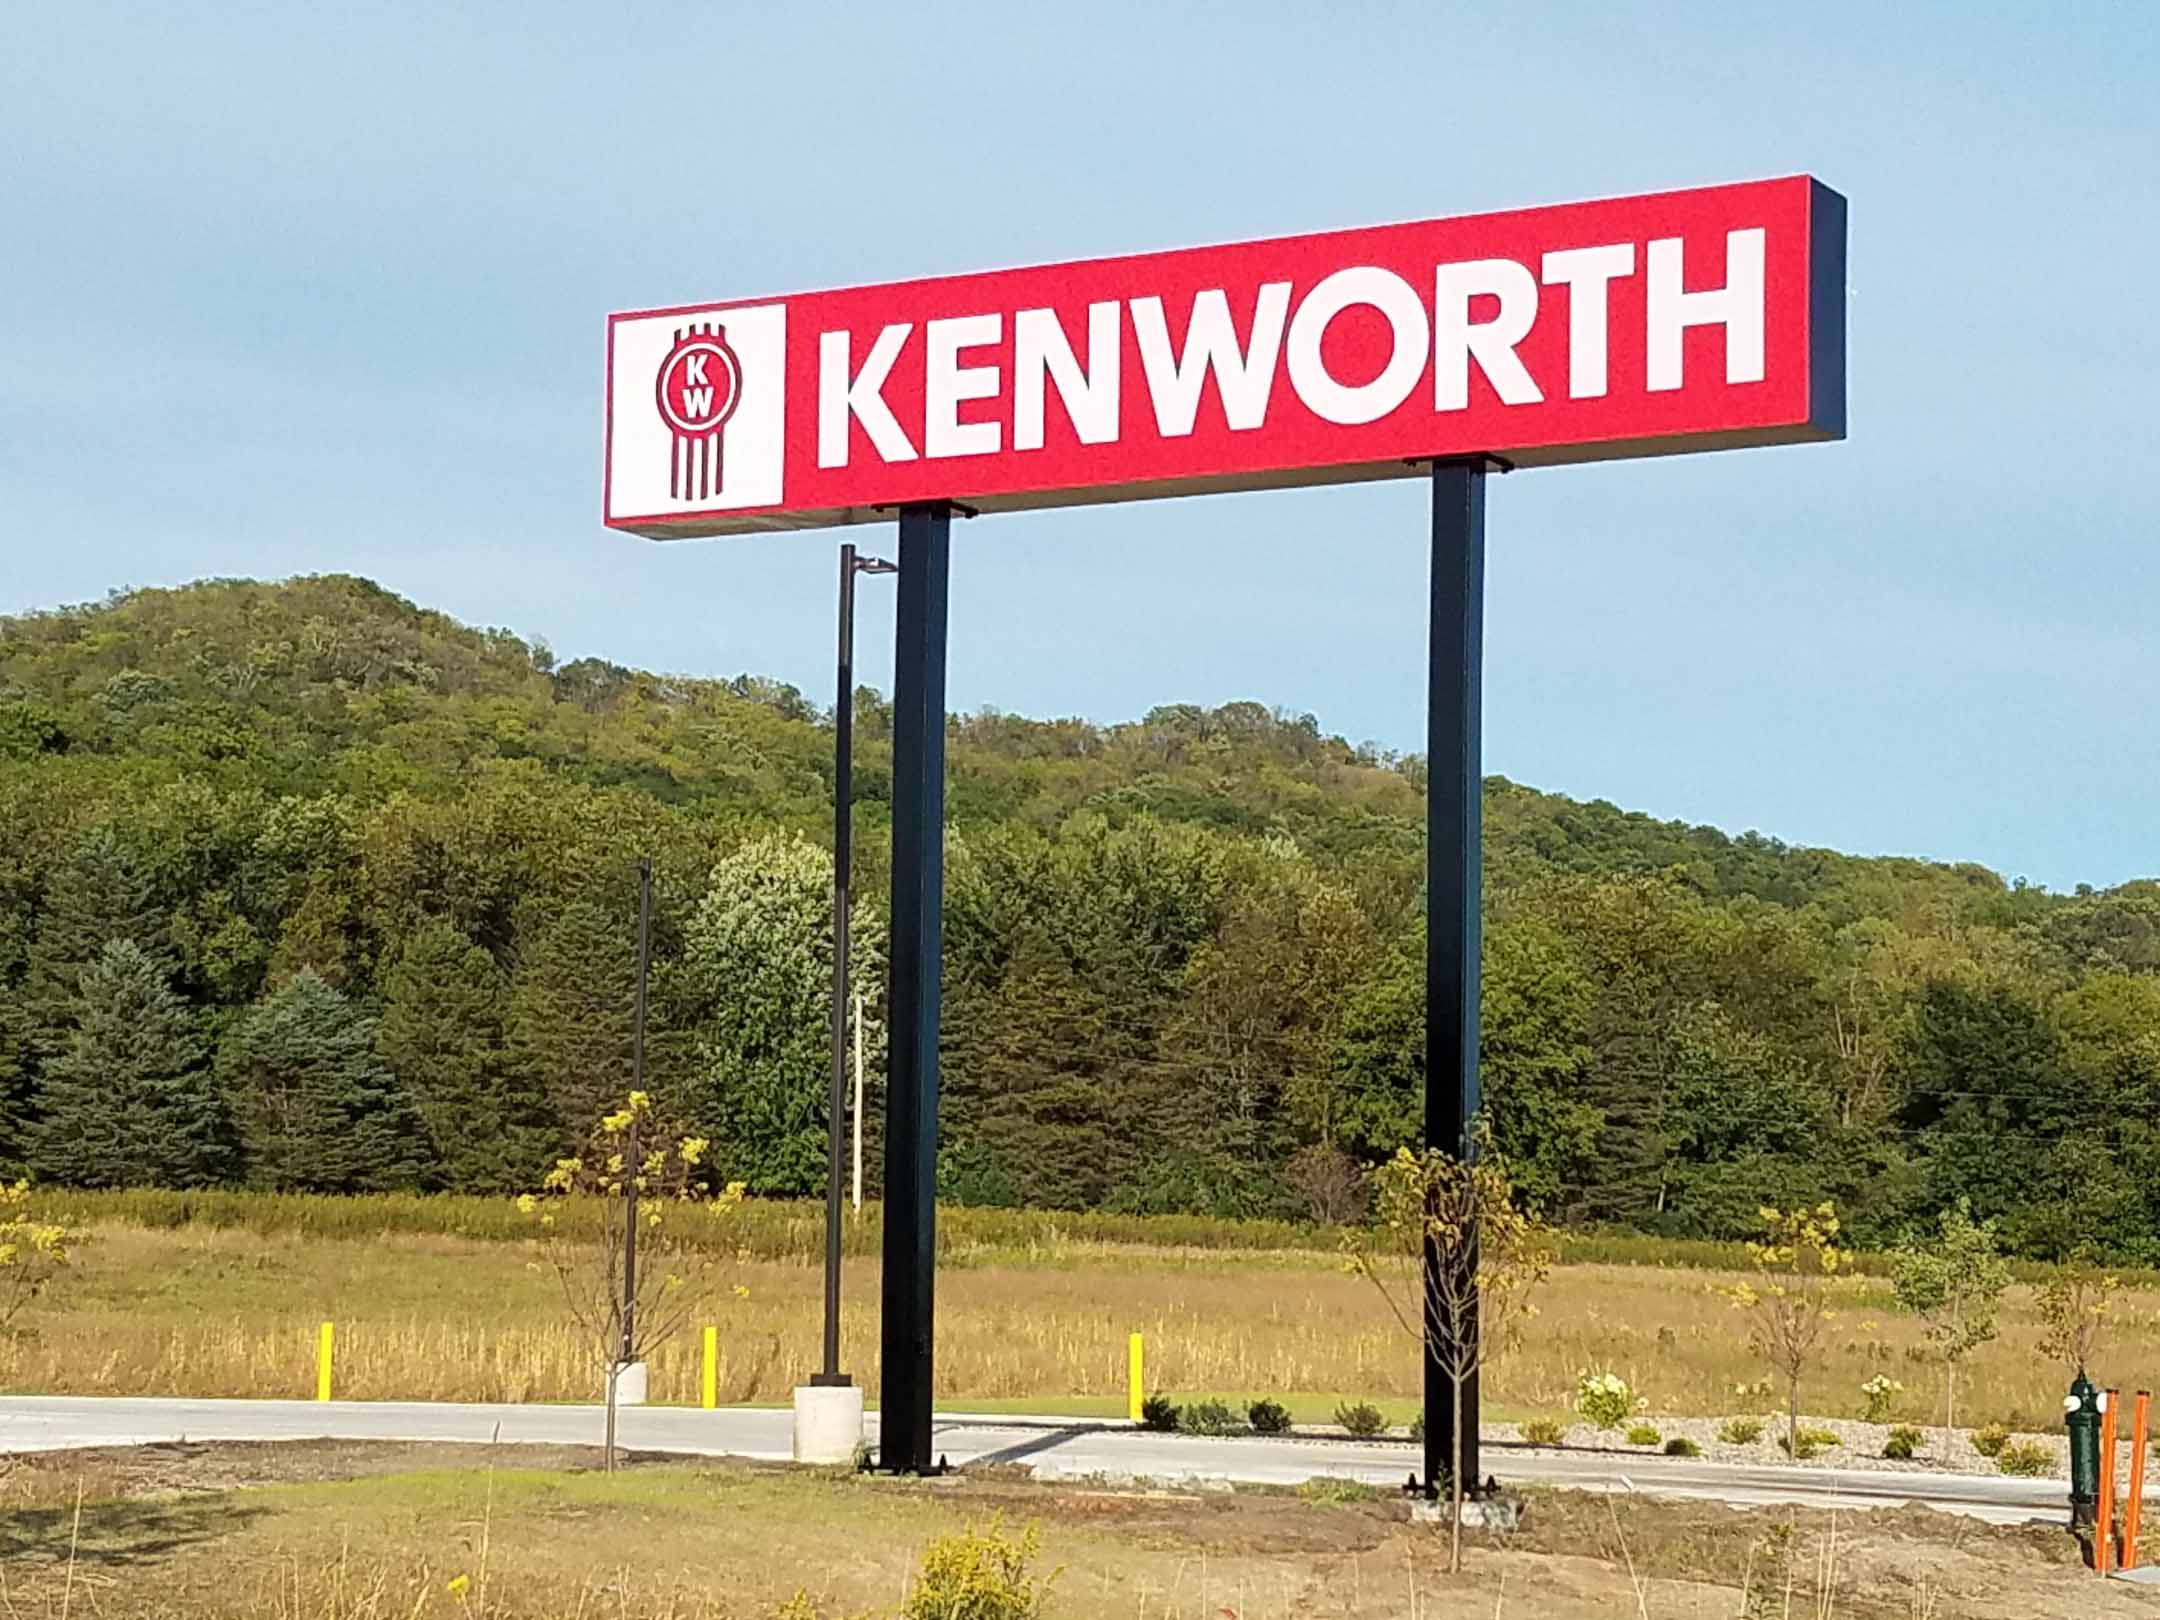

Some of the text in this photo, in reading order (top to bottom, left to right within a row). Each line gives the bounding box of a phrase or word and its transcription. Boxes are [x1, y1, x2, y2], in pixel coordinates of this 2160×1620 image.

[817, 228, 1767, 469] KENWORTH
[686, 354, 709, 386] K
[682, 387, 714, 418] W
